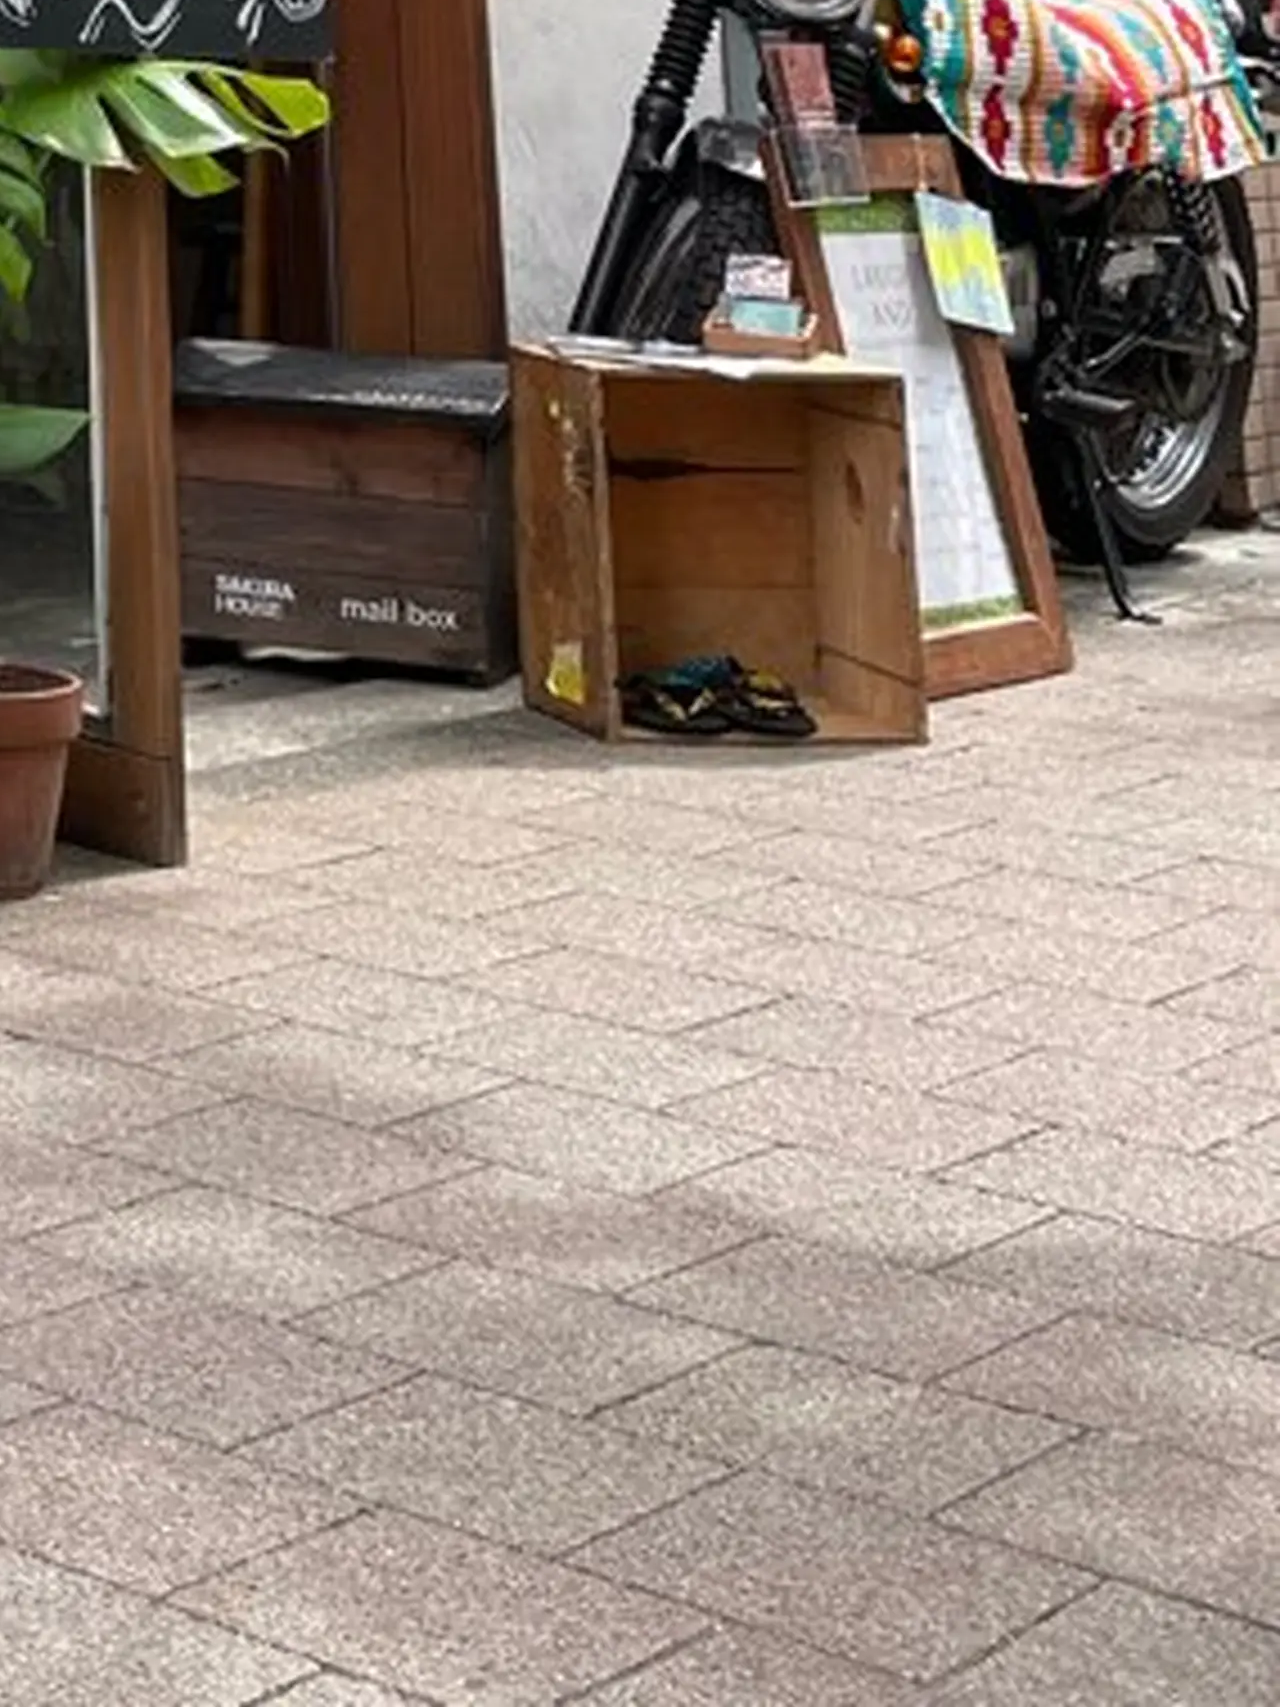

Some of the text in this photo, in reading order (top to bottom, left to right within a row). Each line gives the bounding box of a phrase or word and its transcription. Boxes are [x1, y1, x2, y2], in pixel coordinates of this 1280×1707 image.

[214, 573, 296, 602] SAKURA
[214, 592, 283, 621] HOUSE
[340, 596, 460, 631] mail box
